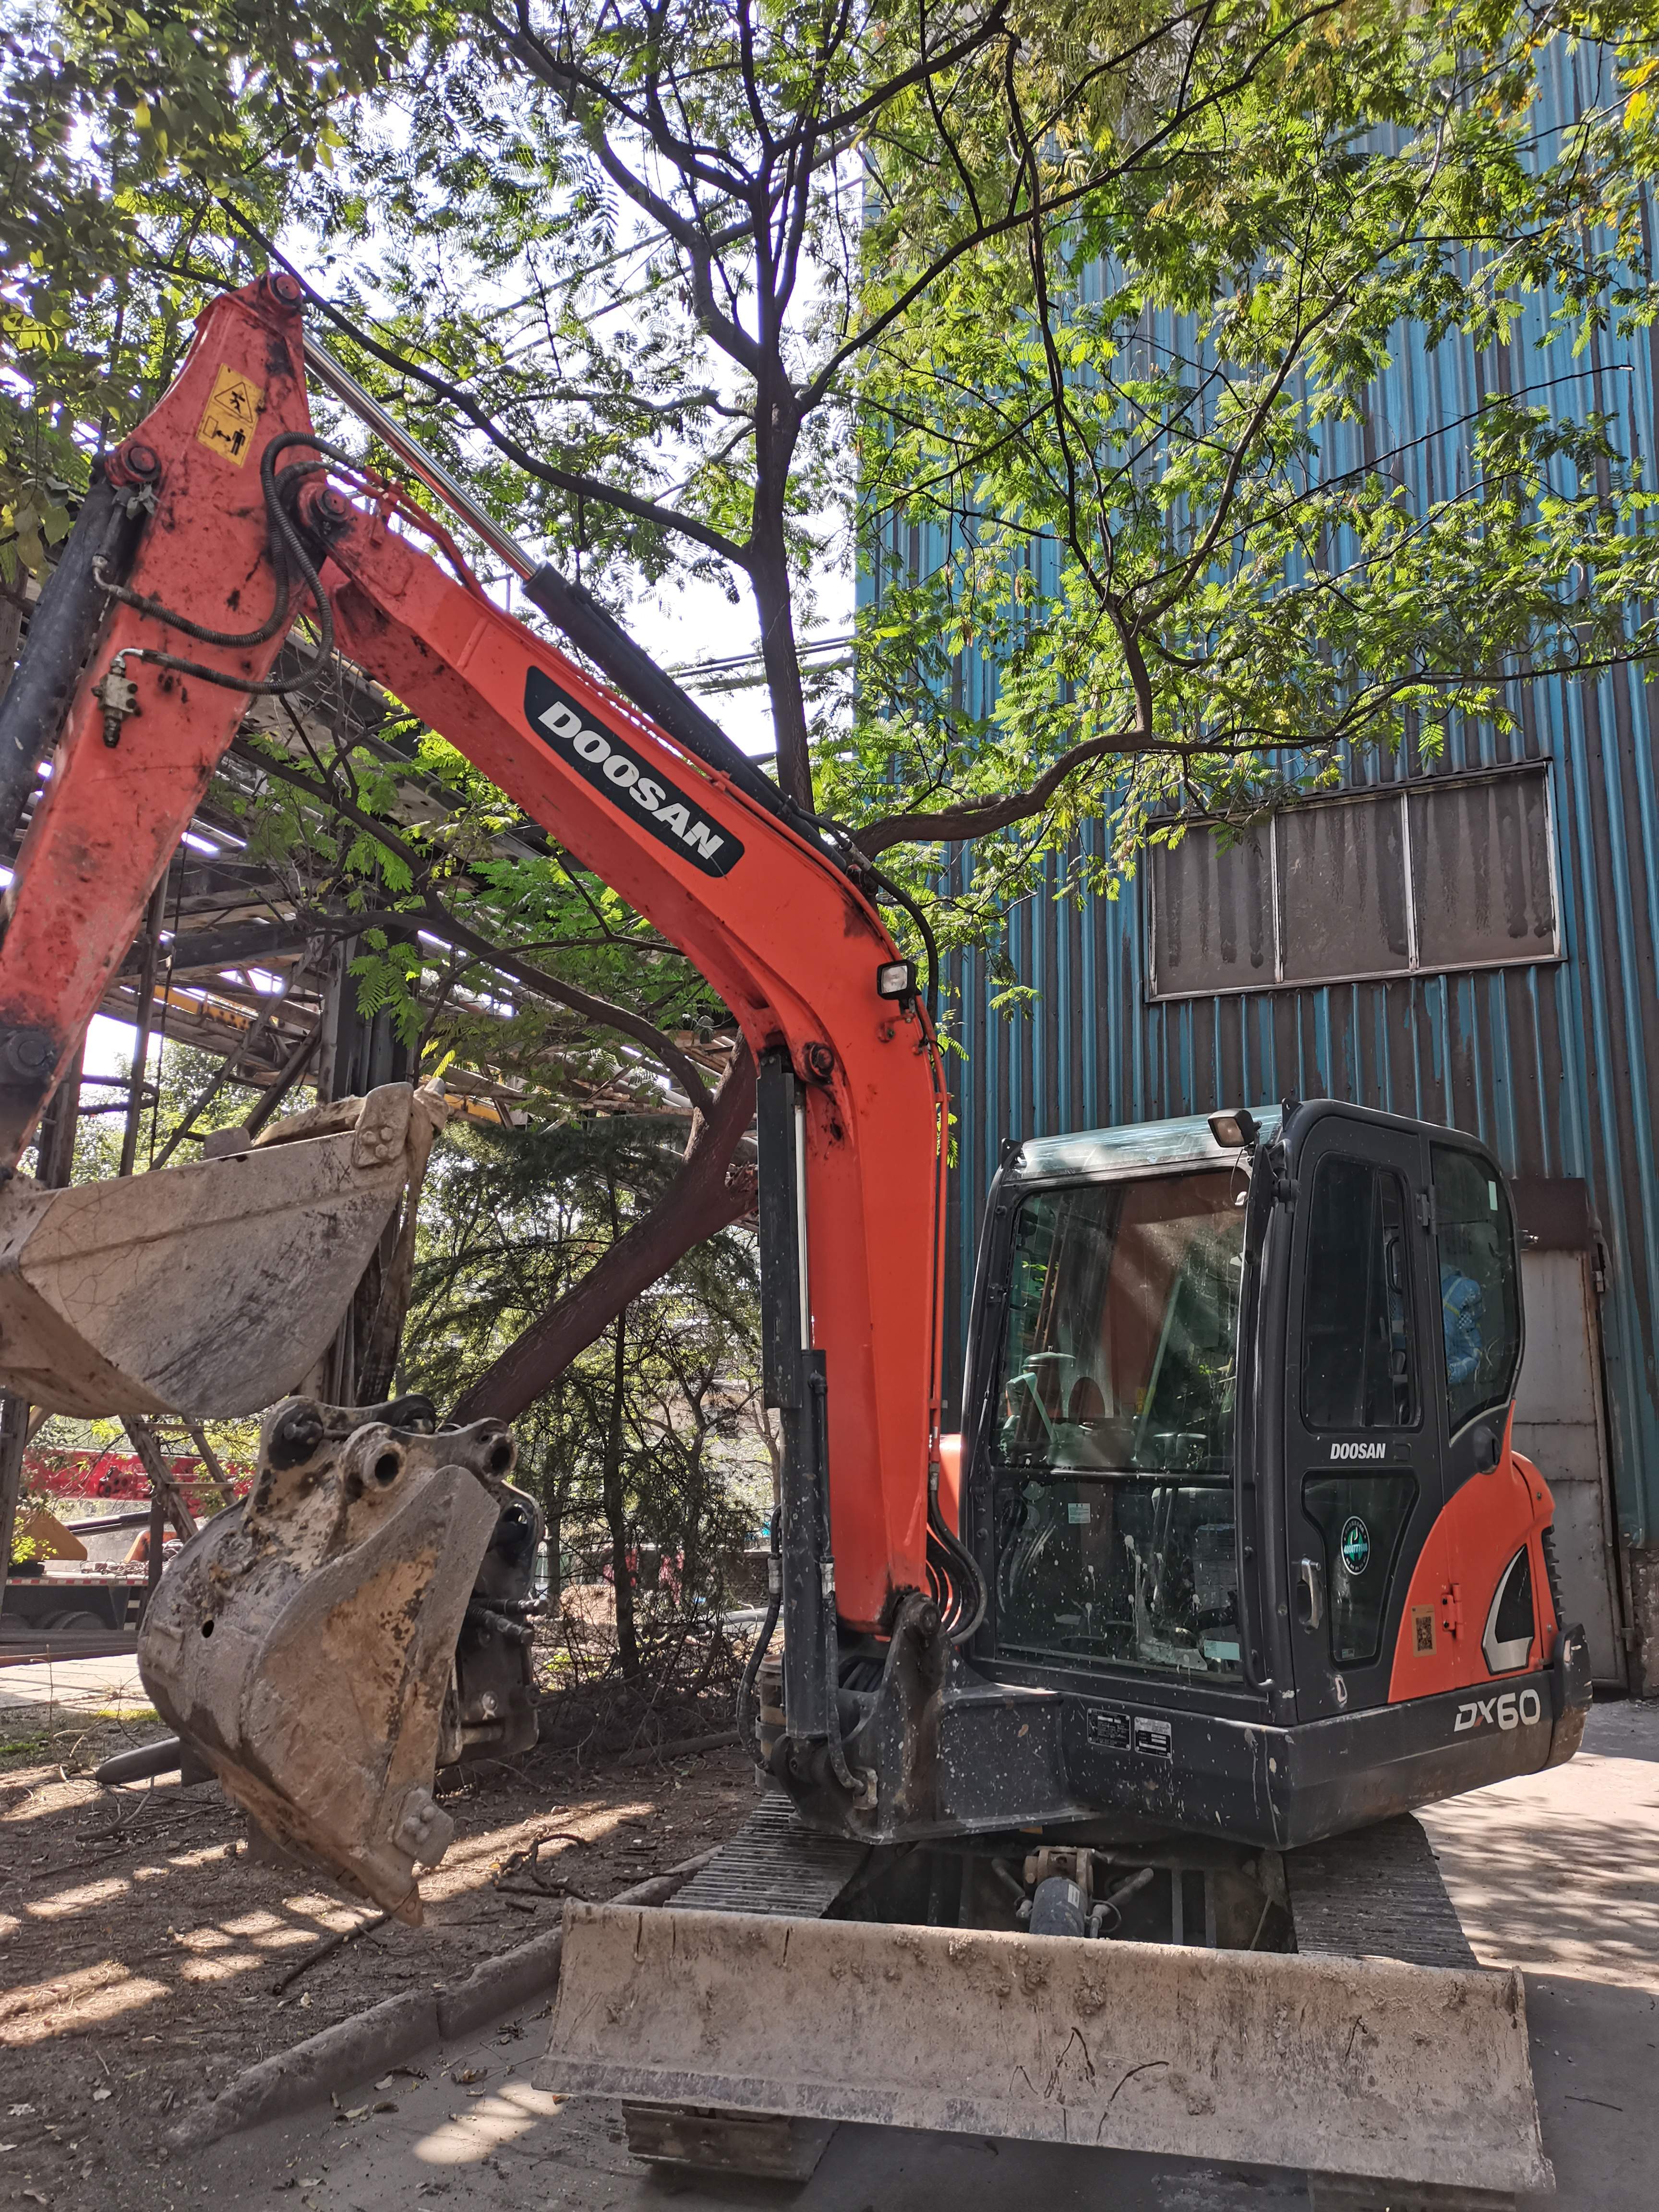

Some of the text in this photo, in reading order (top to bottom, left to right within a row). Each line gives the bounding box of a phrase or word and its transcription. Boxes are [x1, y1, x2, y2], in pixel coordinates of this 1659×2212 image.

[538, 701, 724, 859] DOOSAN
[1330, 1443, 1386, 1459] DOOSAN
[1454, 1689, 1540, 1732] DX60
